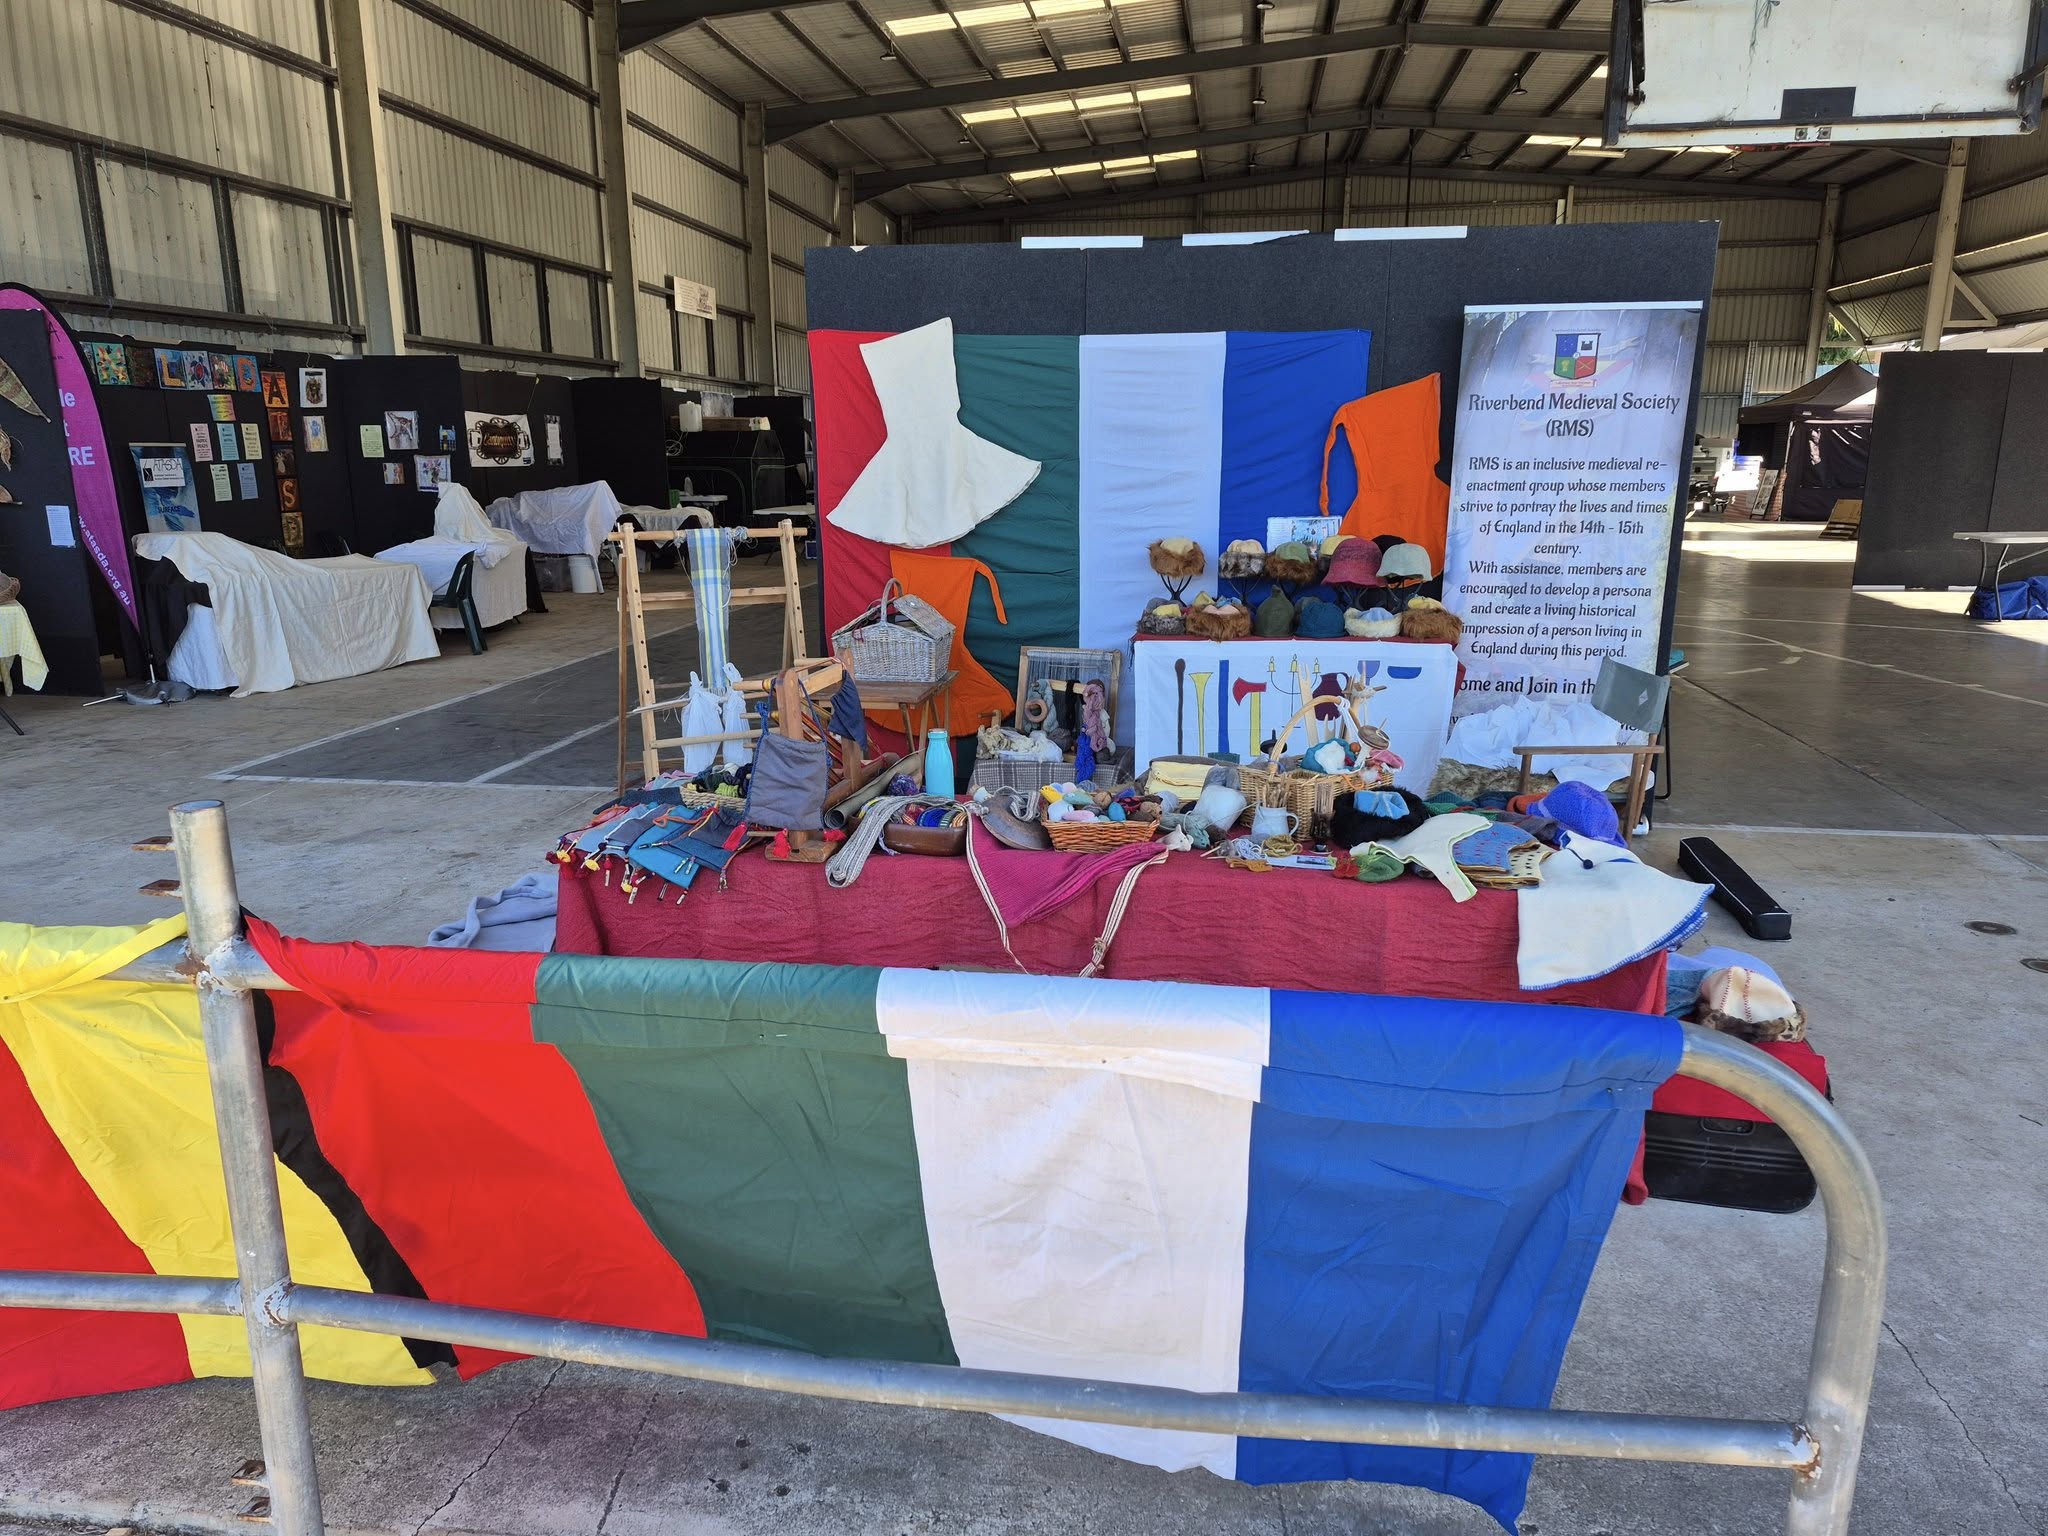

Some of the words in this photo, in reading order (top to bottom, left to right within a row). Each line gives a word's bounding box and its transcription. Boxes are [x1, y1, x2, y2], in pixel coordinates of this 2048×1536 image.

[58, 388, 77, 408] le
[1469, 394, 1546, 411] Riverbend
[1550, 393, 1616, 410] Medieval
[1621, 392, 1680, 414] Society
[1546, 419, 1594, 437] (RMS)
[68, 446, 95, 466] RE
[1469, 457, 1499, 470] RMS
[1503, 458, 1512, 470] is
[1515, 461, 1529, 470] an
[1533, 458, 1585, 470] inclusive
[1588, 458, 1642, 470] medieval
[1646, 461, 1667, 470] re-
[1467, 480, 1528, 491] enactment
[1529, 481, 1564, 496] group
[1568, 480, 1606, 492] whose
[1610, 480, 1665, 492] members
[1460, 502, 1493, 512] strive
[1496, 501, 1507, 512] to
[1510, 501, 1556, 516] portray
[1559, 501, 1577, 513] the
[1580, 501, 1607, 513] lives
[1610, 500, 1632, 513] and
[1636, 501, 1668, 513] times
[1480, 521, 1492, 534] of
[1494, 520, 1541, 537] England
[1545, 523, 1555, 534] in
[1559, 522, 1576, 534] the
[1580, 521, 1605, 534] 14th
[1619, 521, 1644, 534] 15th
[1534, 543, 1582, 558] century.
[1469, 561, 1498, 573] With
[1568, 563, 1623, 575] members
[1626, 566, 1646, 576] are
[1460, 582, 1527, 599] encouraged
[1530, 584, 1541, 595] to
[1545, 583, 1589, 599] develop
[1593, 587, 1600, 595] a
[1603, 586, 1651, 599] persona
[1471, 602, 1492, 614] and
[1495, 604, 1531, 615] create
[1534, 607, 1540, 615] a
[1545, 603, 1575, 620] living
[1579, 604, 1635, 617] historical
[1462, 623, 1524, 638] impression
[1528, 623, 1540, 637] of
[1542, 626, 1548, 635] a
[1552, 626, 1592, 639] person
[1595, 624, 1627, 641] living
[1631, 626, 1642, 638] in
[1471, 641, 1517, 658] England
[1520, 643, 1558, 659] during
[1561, 644, 1582, 656] this
[1585, 646, 1627, 660] period.
[1460, 679, 1491, 692] ome
[1495, 676, 1523, 692] and
[1527, 676, 1557, 695] Join
[1563, 678, 1578, 694] in
[1582, 677, 1596, 694] th
